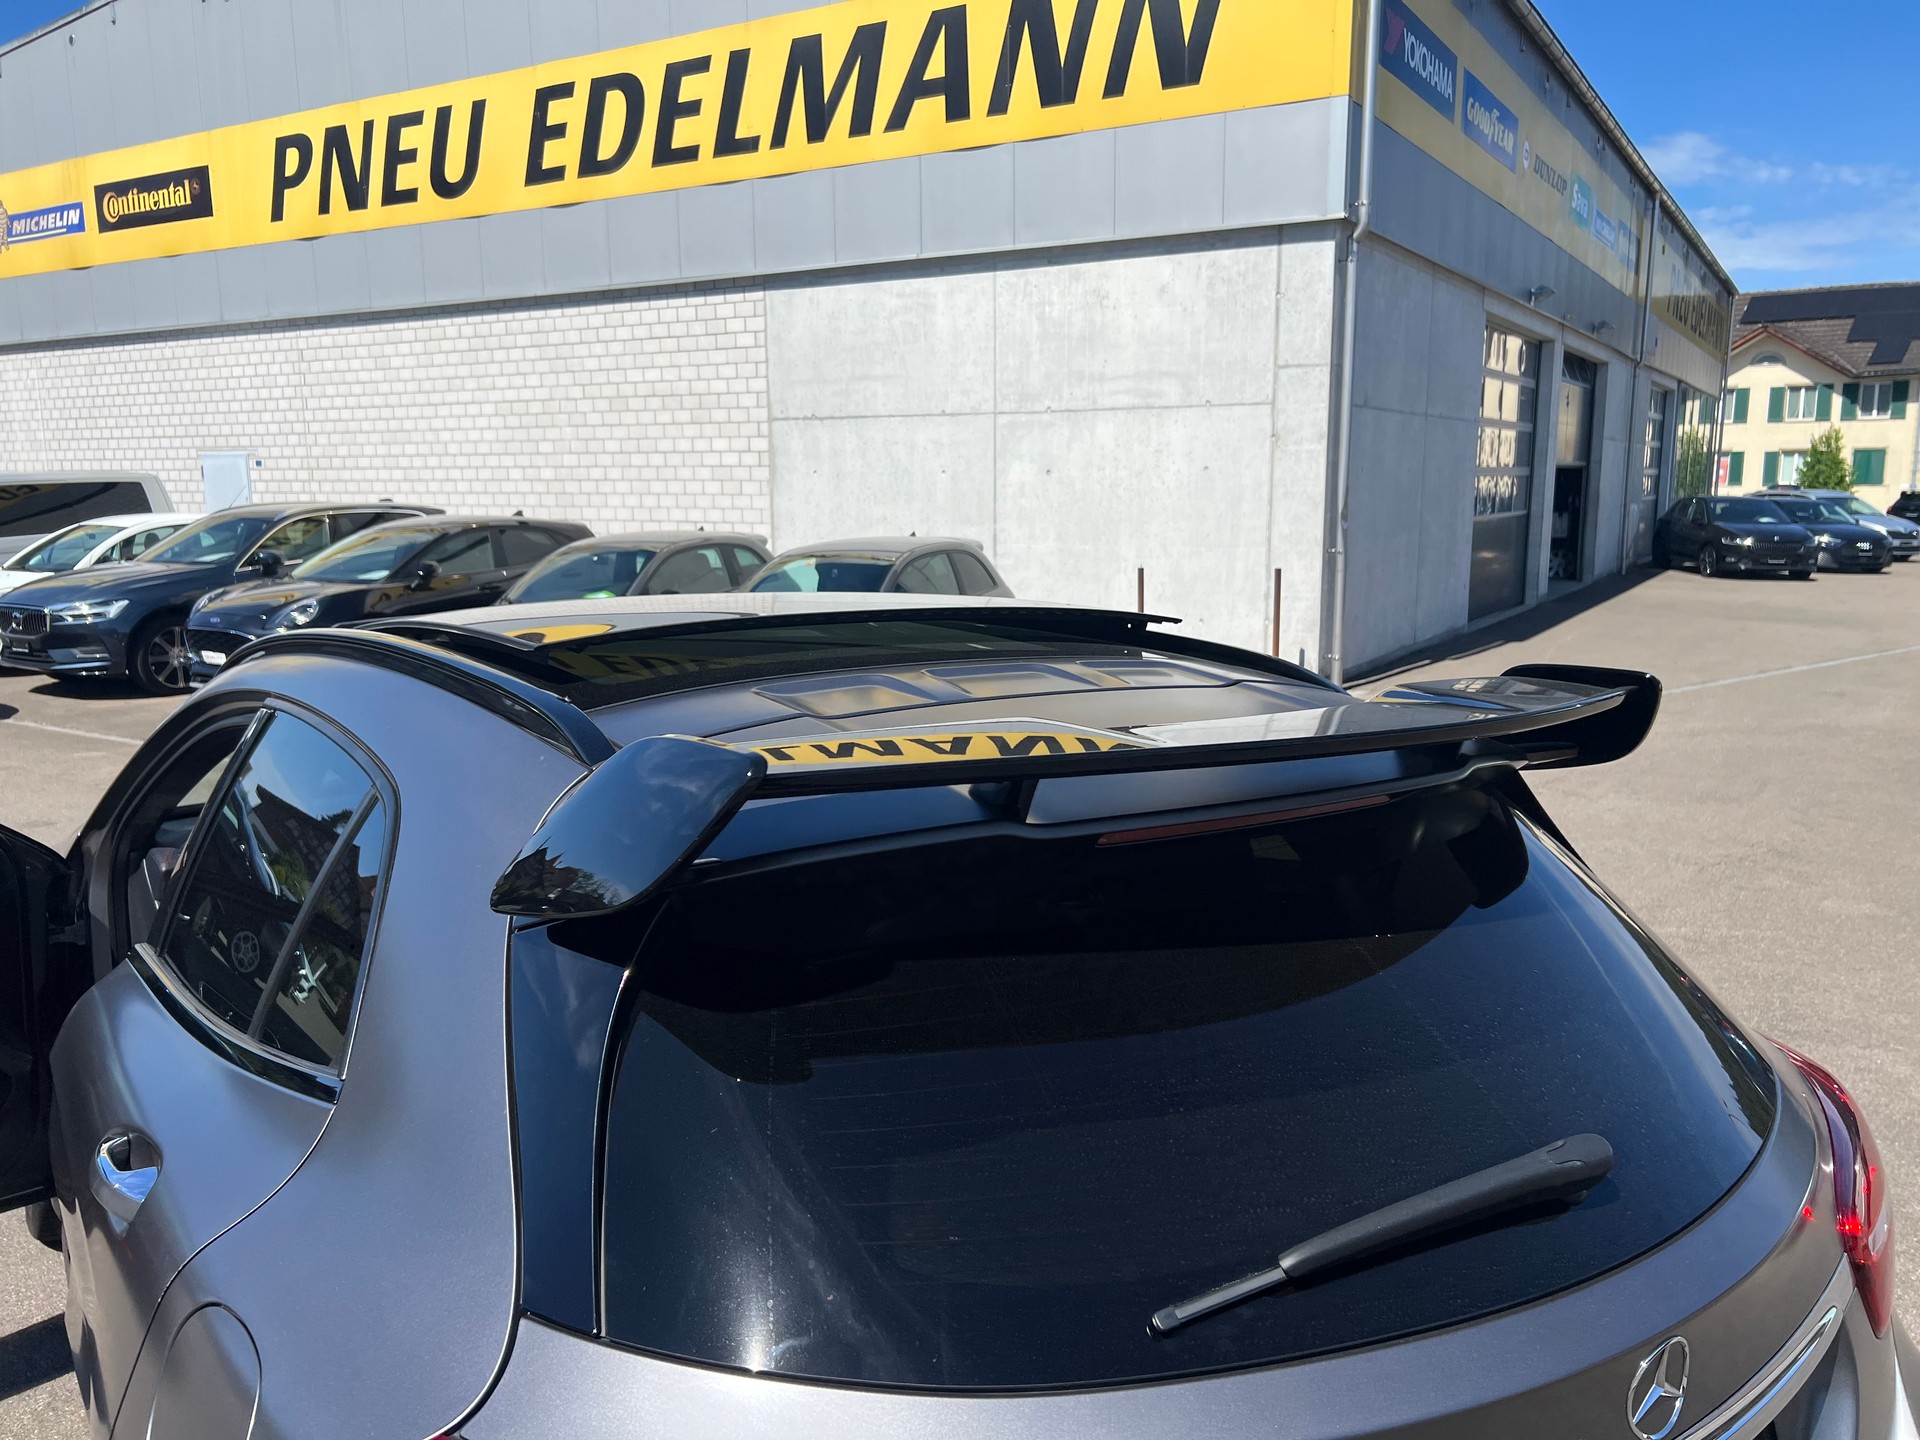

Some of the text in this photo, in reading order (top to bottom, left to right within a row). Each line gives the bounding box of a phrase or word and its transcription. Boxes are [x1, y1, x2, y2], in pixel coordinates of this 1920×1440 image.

[1403, 28, 1453, 102] YOKOHAMA
[271, 0, 1220, 222] PNEU EDELMANN
[1533, 153, 1568, 196] DUNLOP
[12, 208, 80, 235] MICHELIN
[103, 179, 192, 223] Continental
